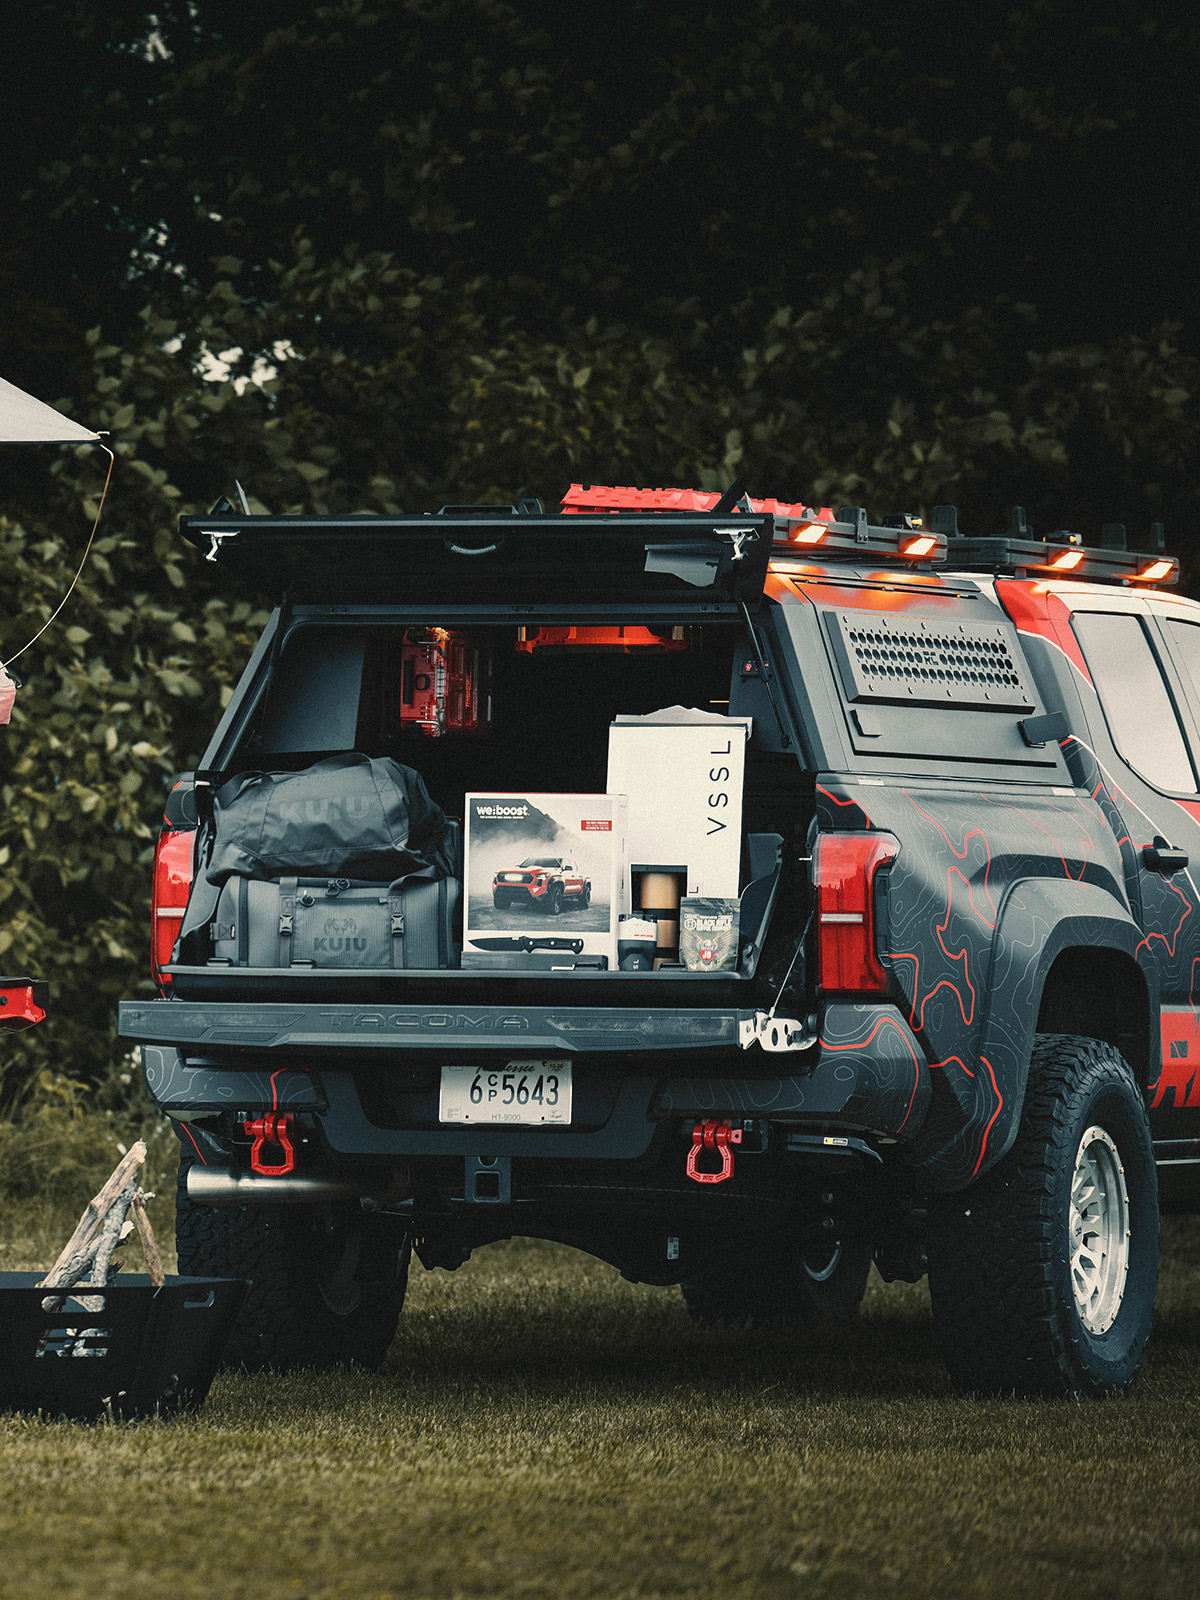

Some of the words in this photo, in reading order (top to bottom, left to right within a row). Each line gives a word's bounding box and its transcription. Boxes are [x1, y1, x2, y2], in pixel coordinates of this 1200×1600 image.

[706, 740, 732, 836] VSSL
[313, 937, 368, 952] KUIU
[319, 1012, 530, 1029] TACOMA
